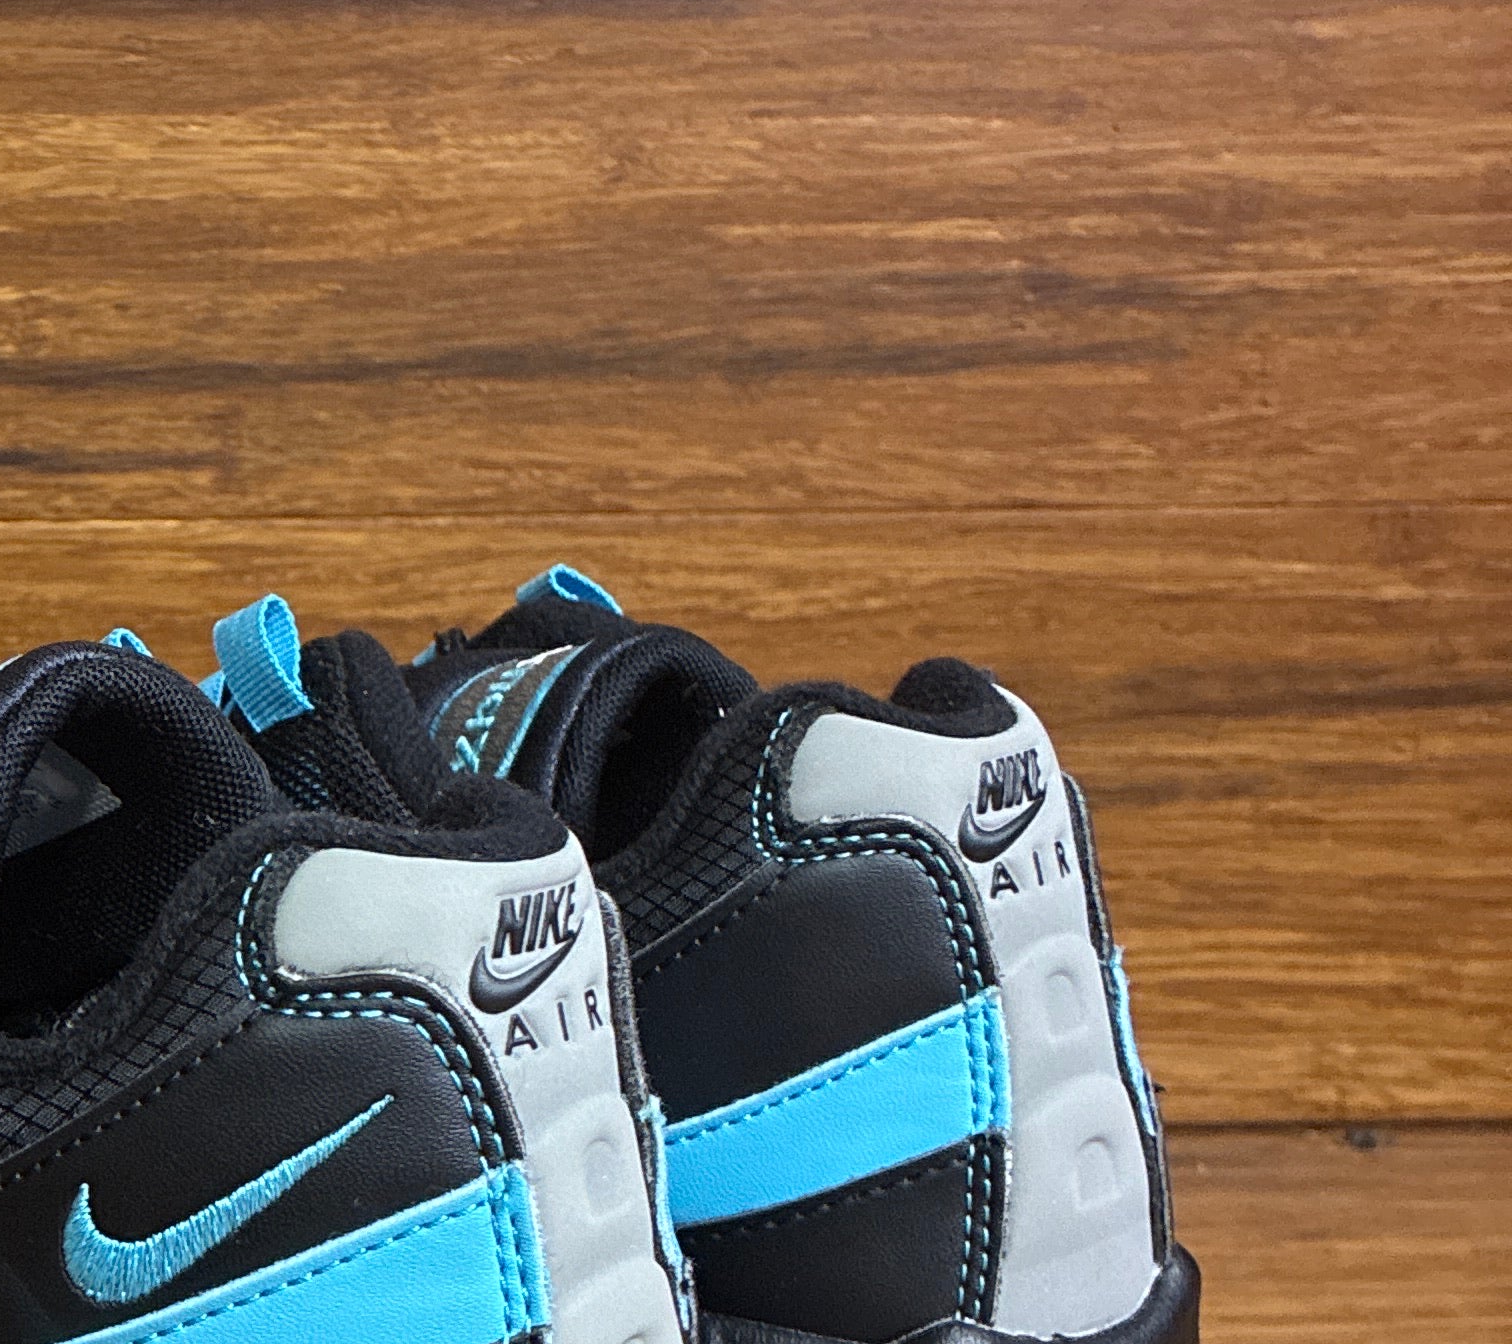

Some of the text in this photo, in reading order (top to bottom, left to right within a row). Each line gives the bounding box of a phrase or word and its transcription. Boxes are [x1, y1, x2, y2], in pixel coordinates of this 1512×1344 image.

[989, 840, 1071, 900] AIR
[491, 880, 577, 959] NIKE
[503, 988, 603, 1056] AIR
